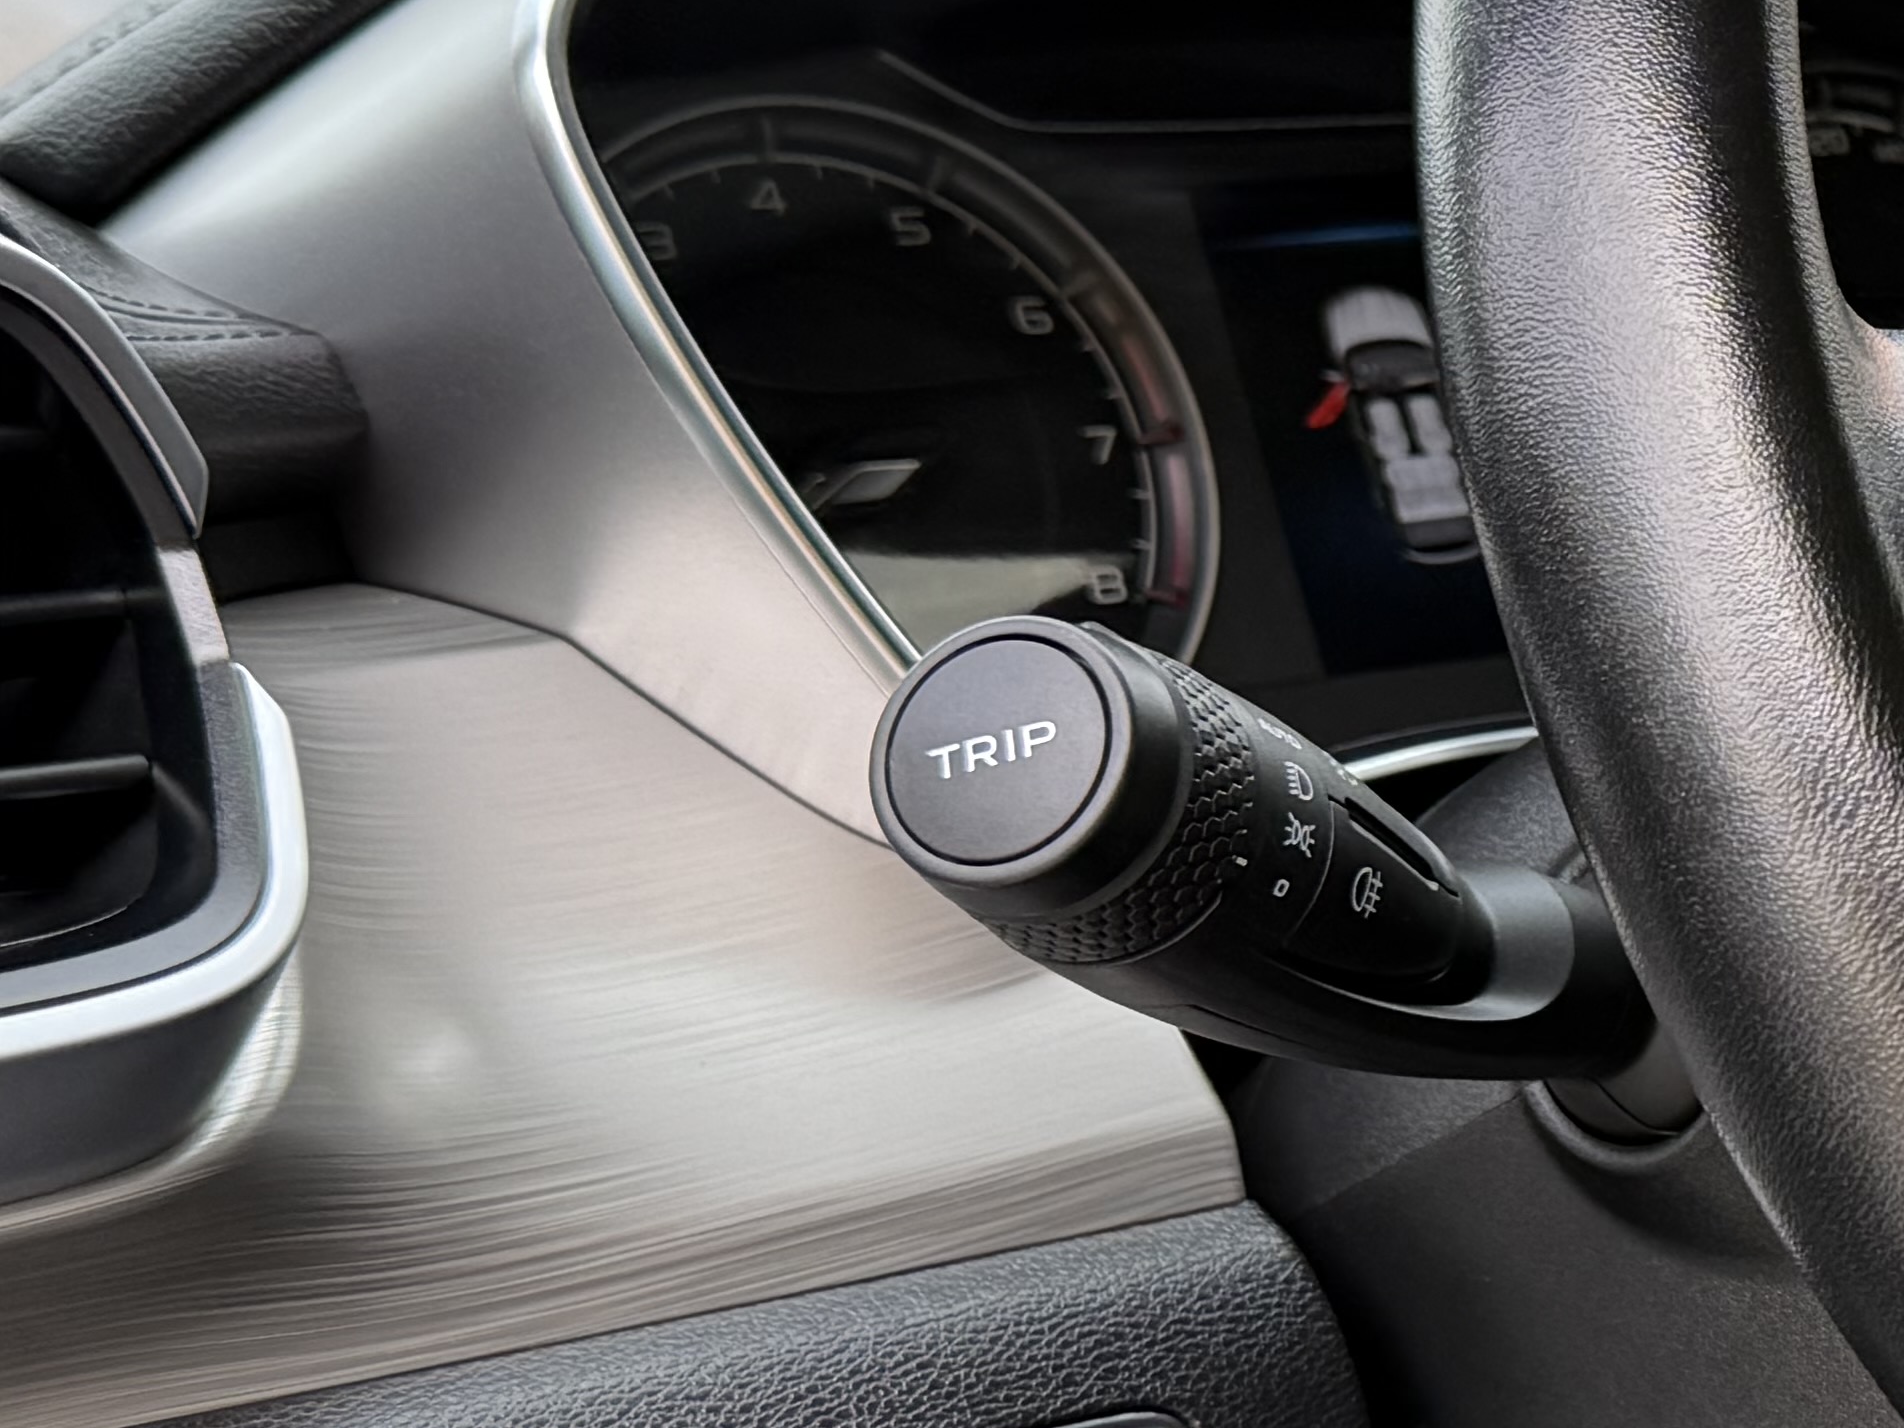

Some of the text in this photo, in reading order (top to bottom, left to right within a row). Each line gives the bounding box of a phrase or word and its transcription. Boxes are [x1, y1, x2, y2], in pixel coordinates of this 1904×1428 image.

[751, 182, 787, 216] 4
[891, 208, 931, 246] 5
[1013, 299, 1054, 334] 6
[1081, 427, 1116, 464] 7
[1088, 568, 1127, 604] 8
[925, 720, 1057, 779] TRIP
